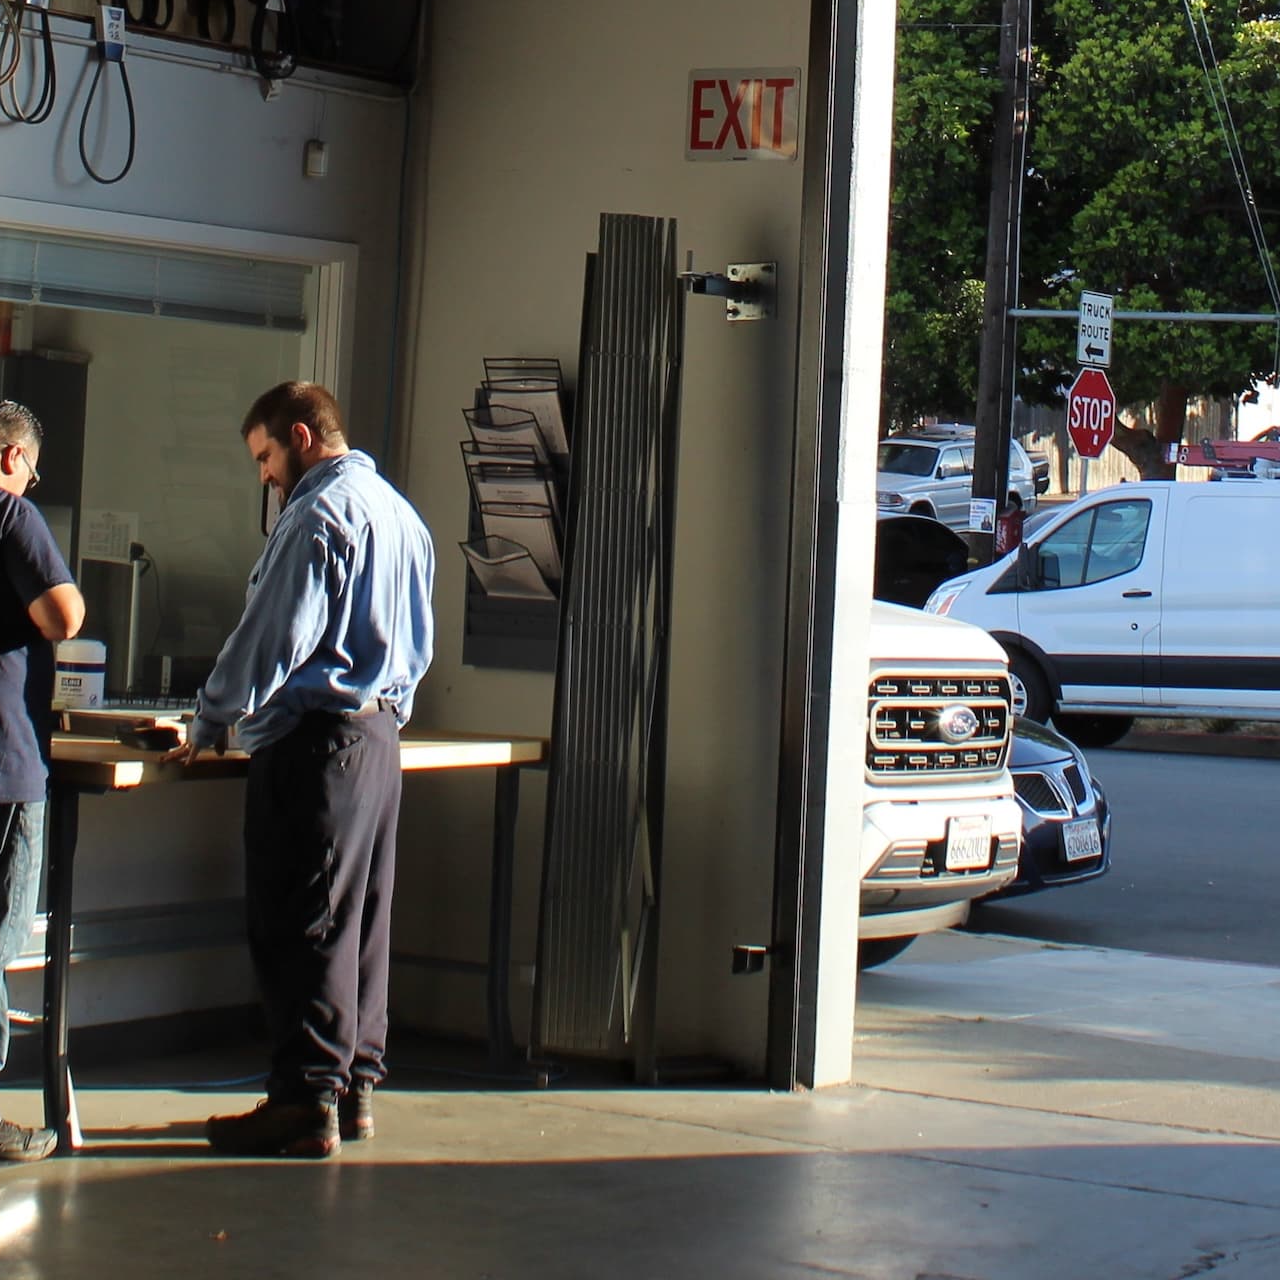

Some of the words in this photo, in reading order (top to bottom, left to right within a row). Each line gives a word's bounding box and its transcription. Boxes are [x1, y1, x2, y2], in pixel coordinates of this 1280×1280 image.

[690, 78, 795, 150] EXIT
[1082, 302, 1111, 319] TRUCK
[1080, 324, 1110, 341] ROUTE
[1070, 395, 1112, 432] STOP
